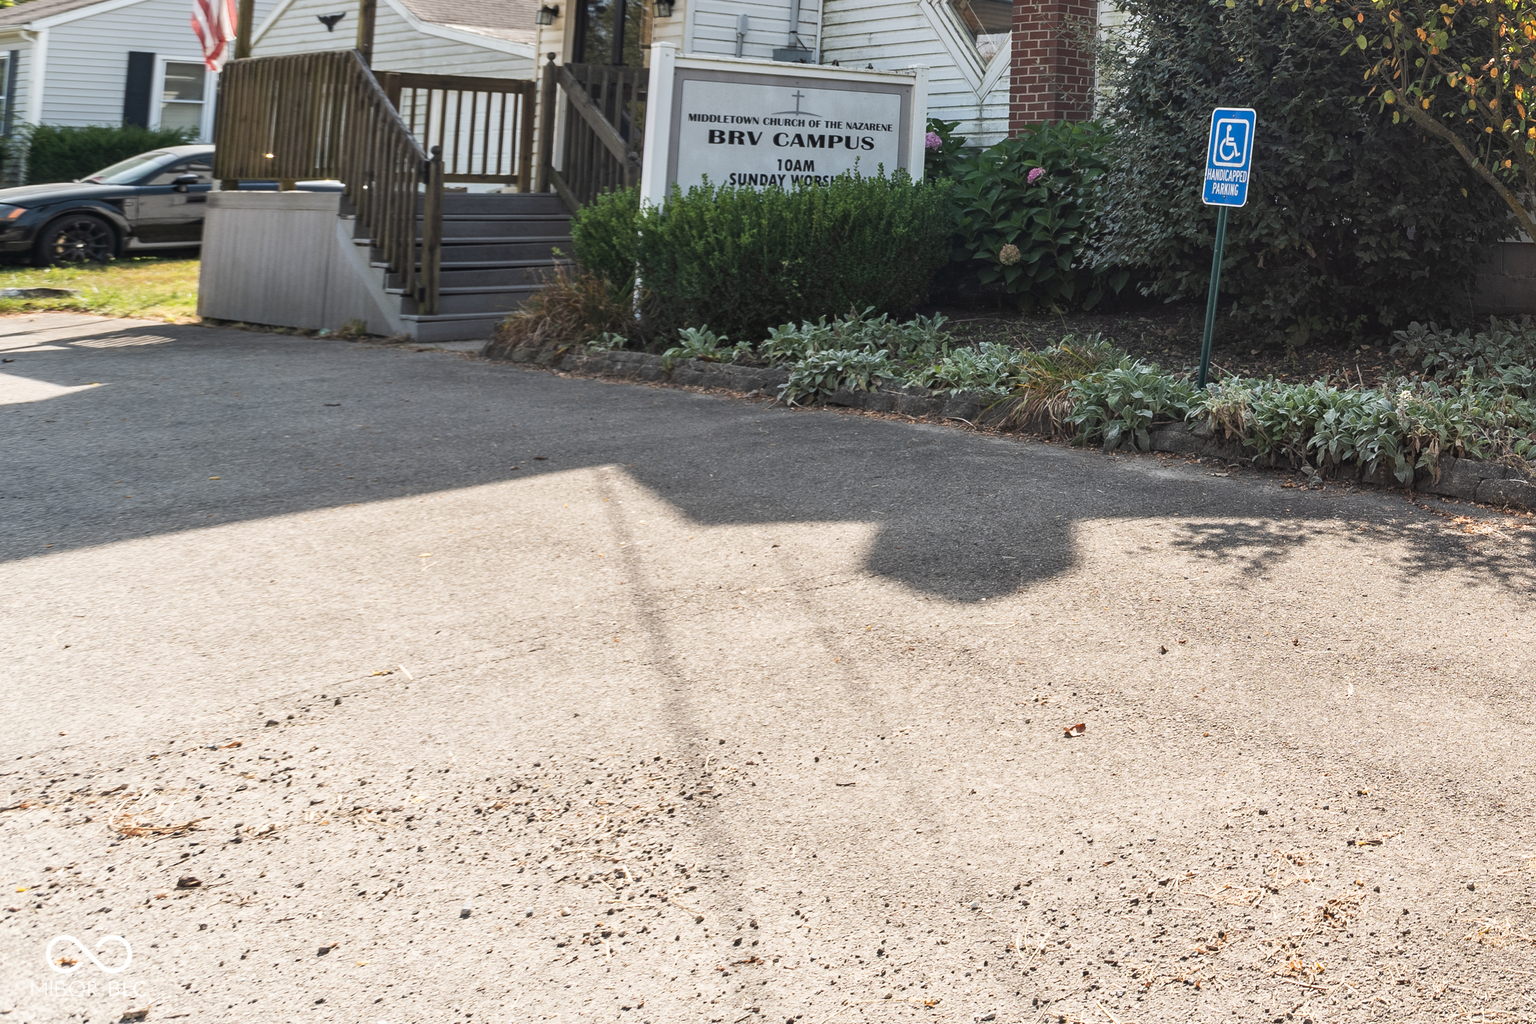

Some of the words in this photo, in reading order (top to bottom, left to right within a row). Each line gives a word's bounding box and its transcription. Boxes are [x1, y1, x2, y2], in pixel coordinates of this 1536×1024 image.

[688, 113, 760, 125] MIDDLETOWN
[762, 117, 805, 128] CHURCH
[808, 119, 822, 129] OF
[824, 120, 843, 129] THE
[845, 121, 893, 132] NAZARENE
[708, 129, 763, 146] BRV
[772, 132, 875, 151] CAMPUS
[777, 159, 815, 172] 10AM
[729, 173, 786, 187] SUNDAY
[790, 175, 853, 188] WORSH
[1207, 168, 1247, 183] HANDICAPPED
[1211, 182, 1239, 196] PARKING
